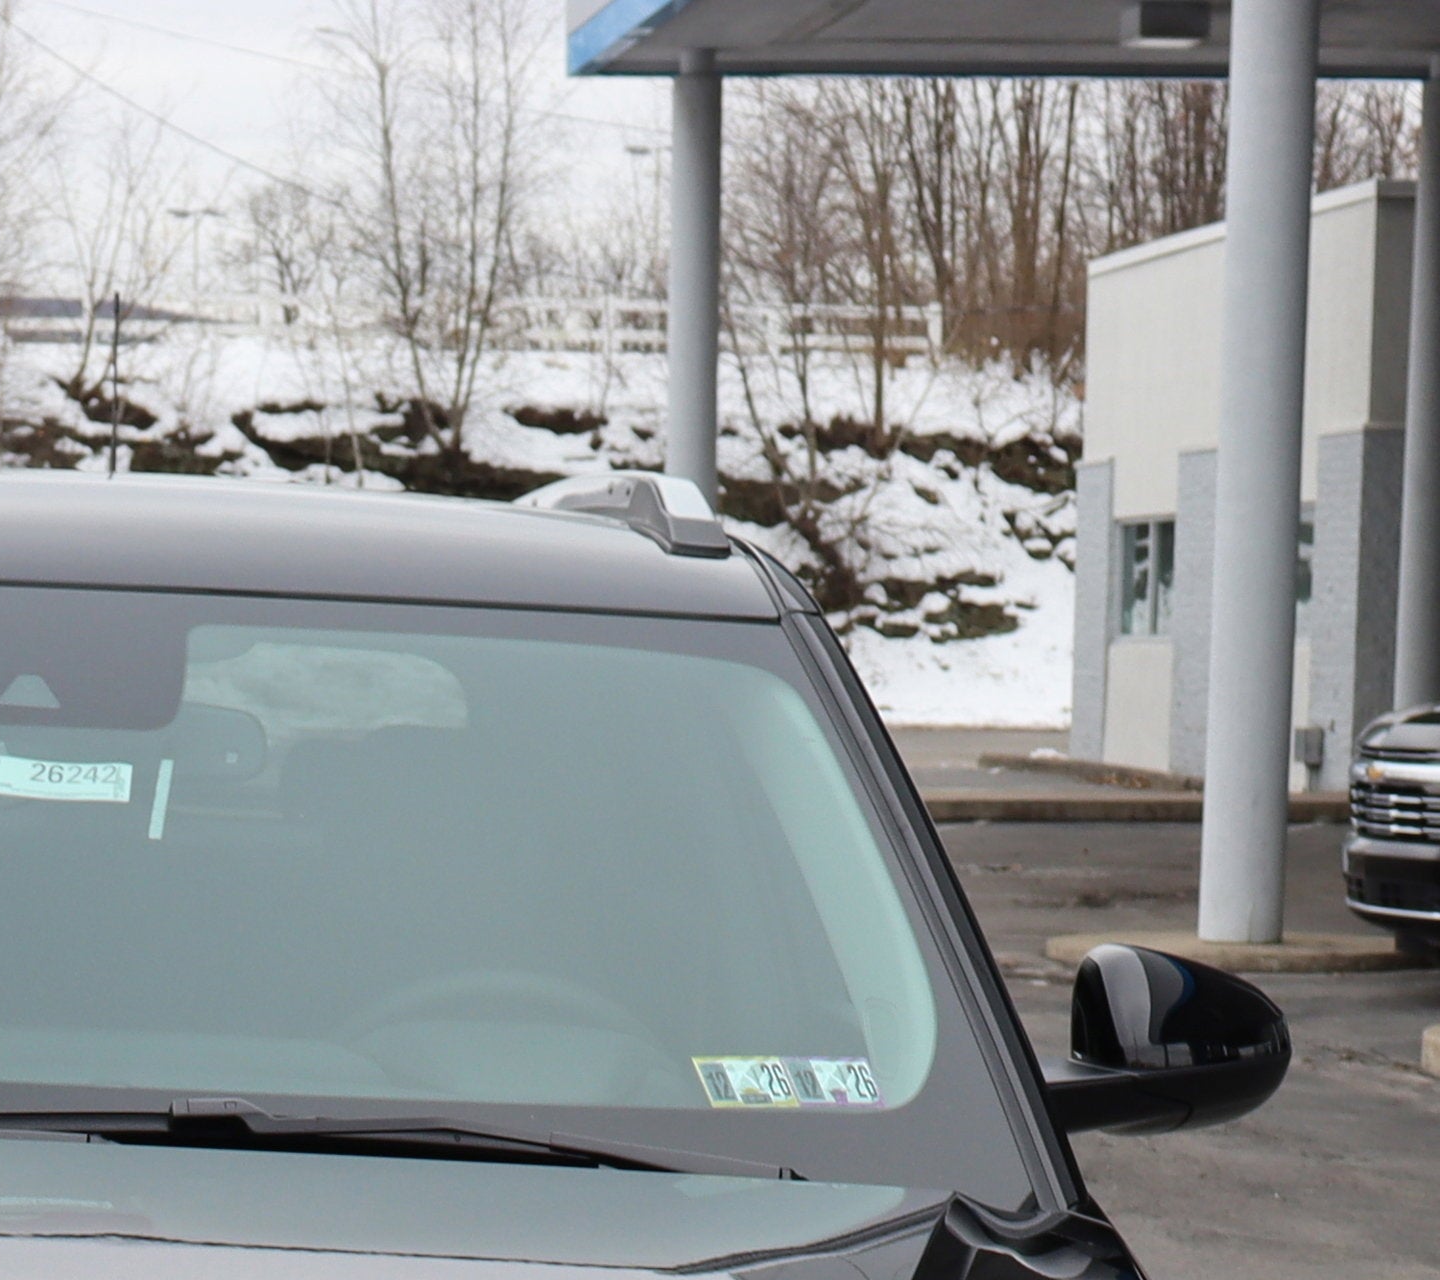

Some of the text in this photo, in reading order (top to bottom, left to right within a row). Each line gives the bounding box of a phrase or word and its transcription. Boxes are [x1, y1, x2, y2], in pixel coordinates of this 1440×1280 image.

[29, 762, 118, 784] 26242
[761, 1063, 792, 1097] 26
[848, 1064, 878, 1099] 26
